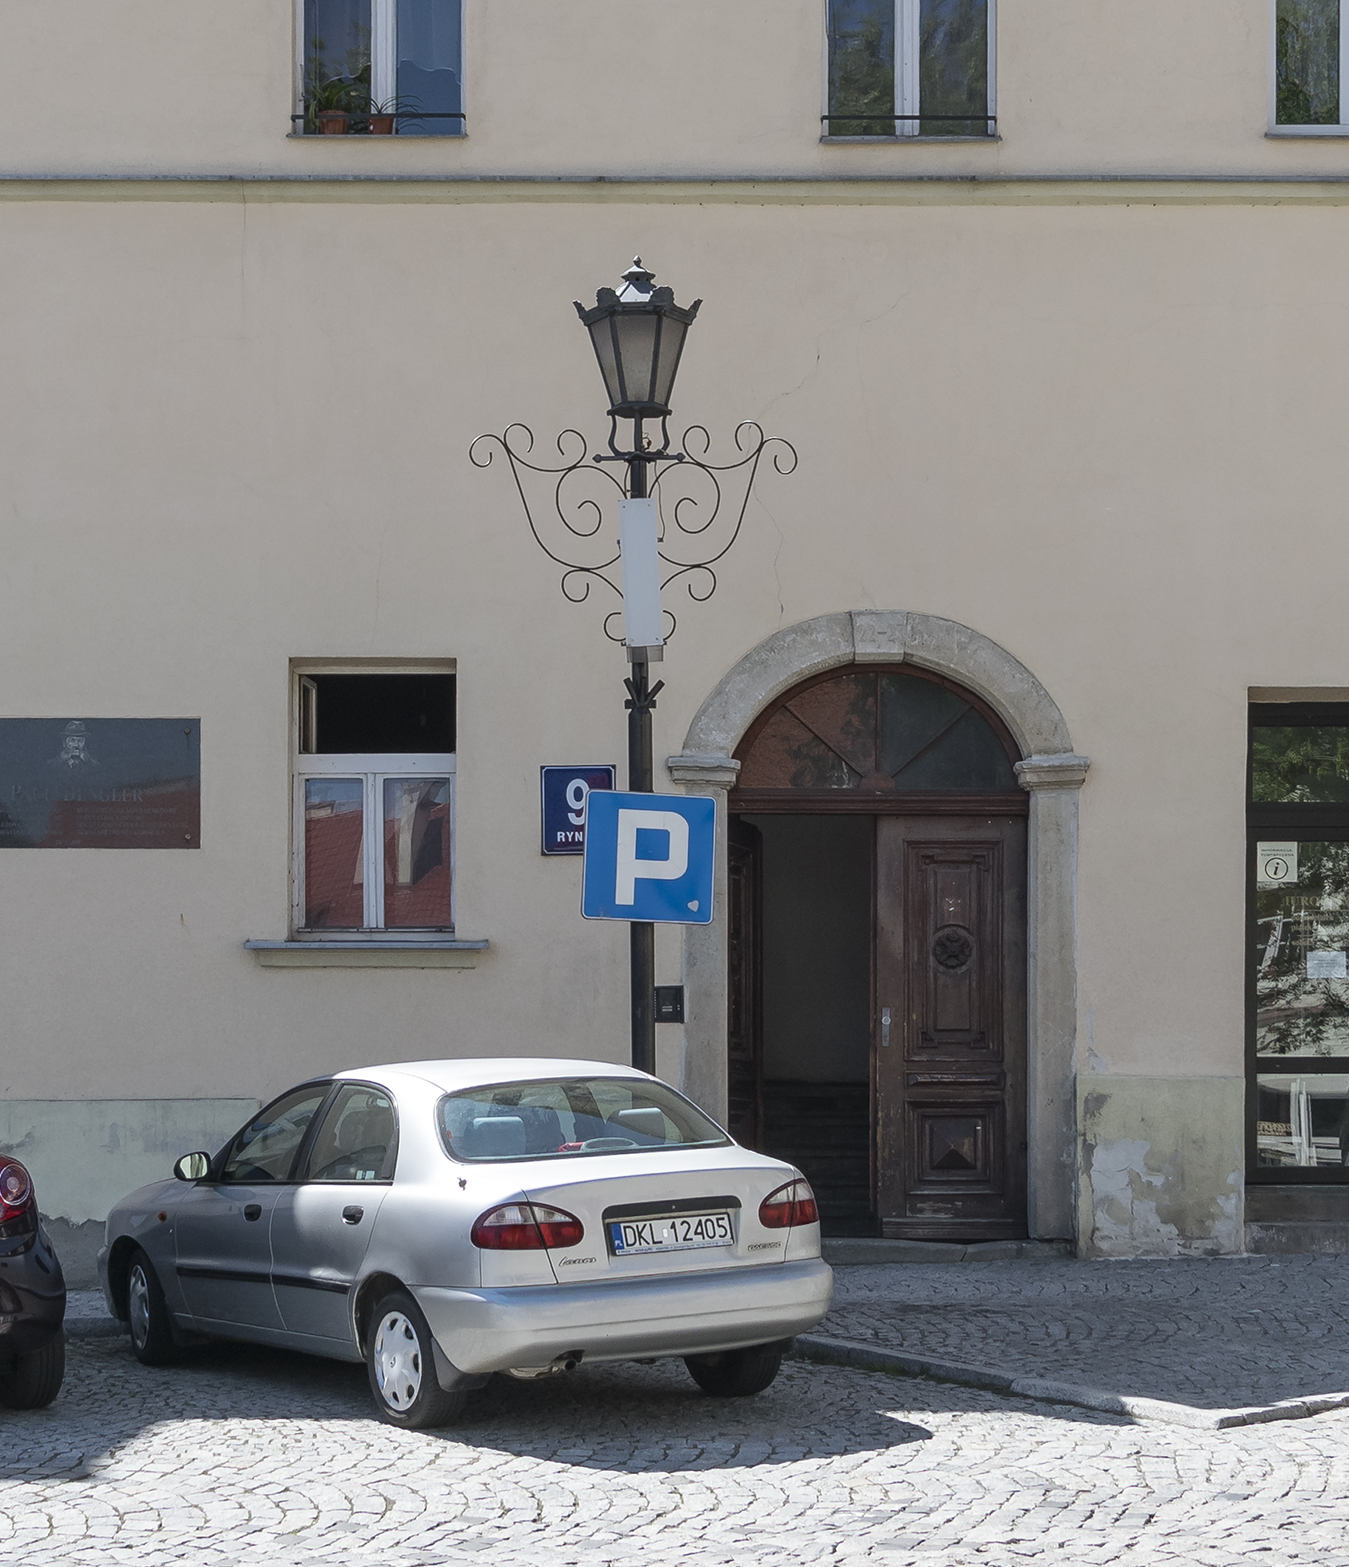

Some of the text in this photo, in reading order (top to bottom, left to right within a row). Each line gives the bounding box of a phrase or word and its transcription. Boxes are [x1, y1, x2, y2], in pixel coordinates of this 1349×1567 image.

[565, 778, 588, 826] 9
[557, 831, 583, 843] RYN
[615, 808, 690, 906] P
[623, 1222, 663, 1248] DKL
[669, 1216, 728, 1244] 12405
